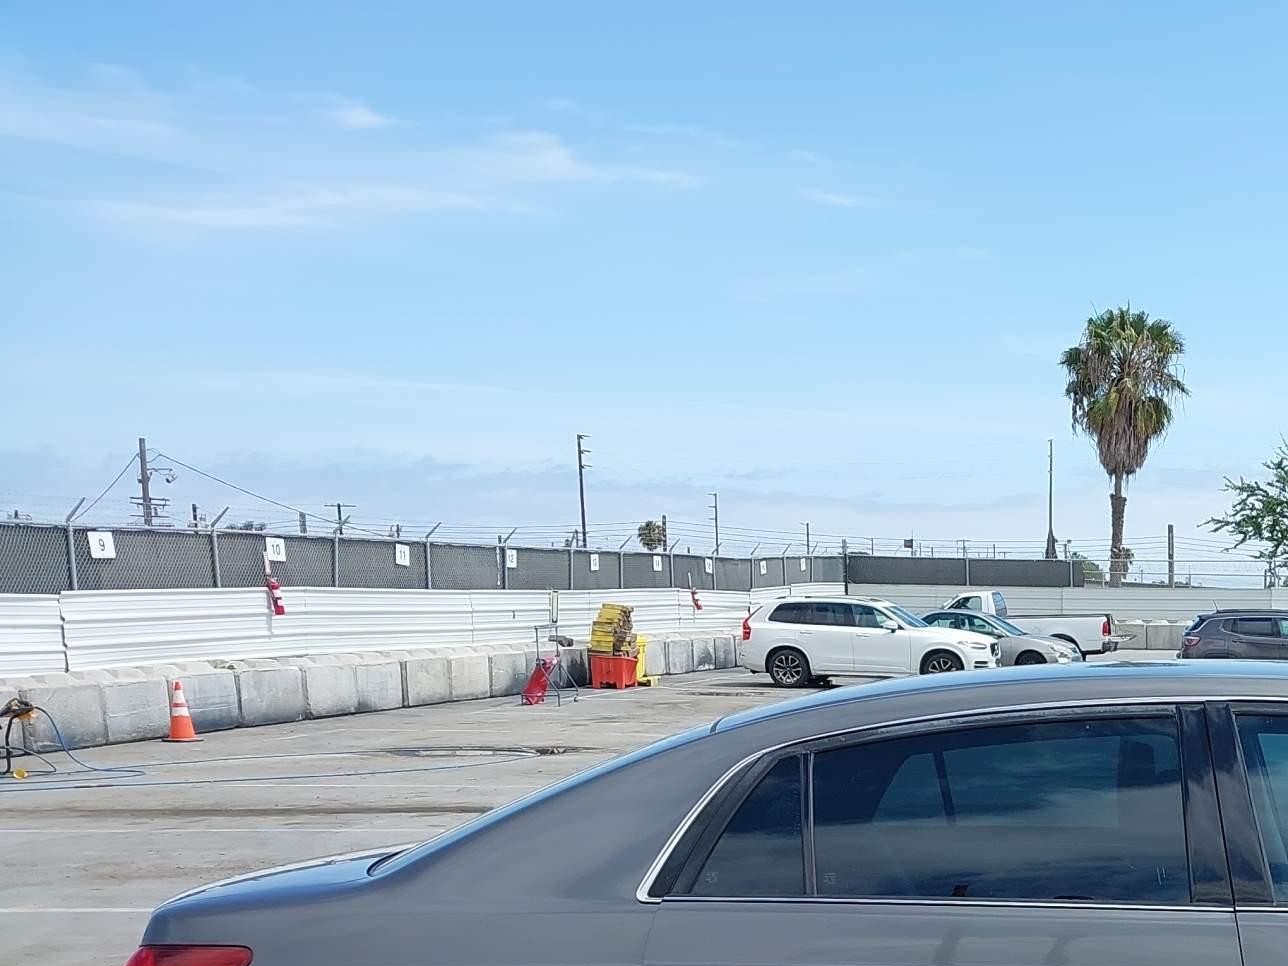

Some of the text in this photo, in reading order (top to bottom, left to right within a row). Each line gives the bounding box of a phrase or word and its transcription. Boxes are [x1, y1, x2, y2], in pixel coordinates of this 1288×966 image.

[98, 538, 106, 552] 9
[271, 543, 282, 556] 10
[399, 549, 407, 561] 11
[508, 553, 515, 564] 12
